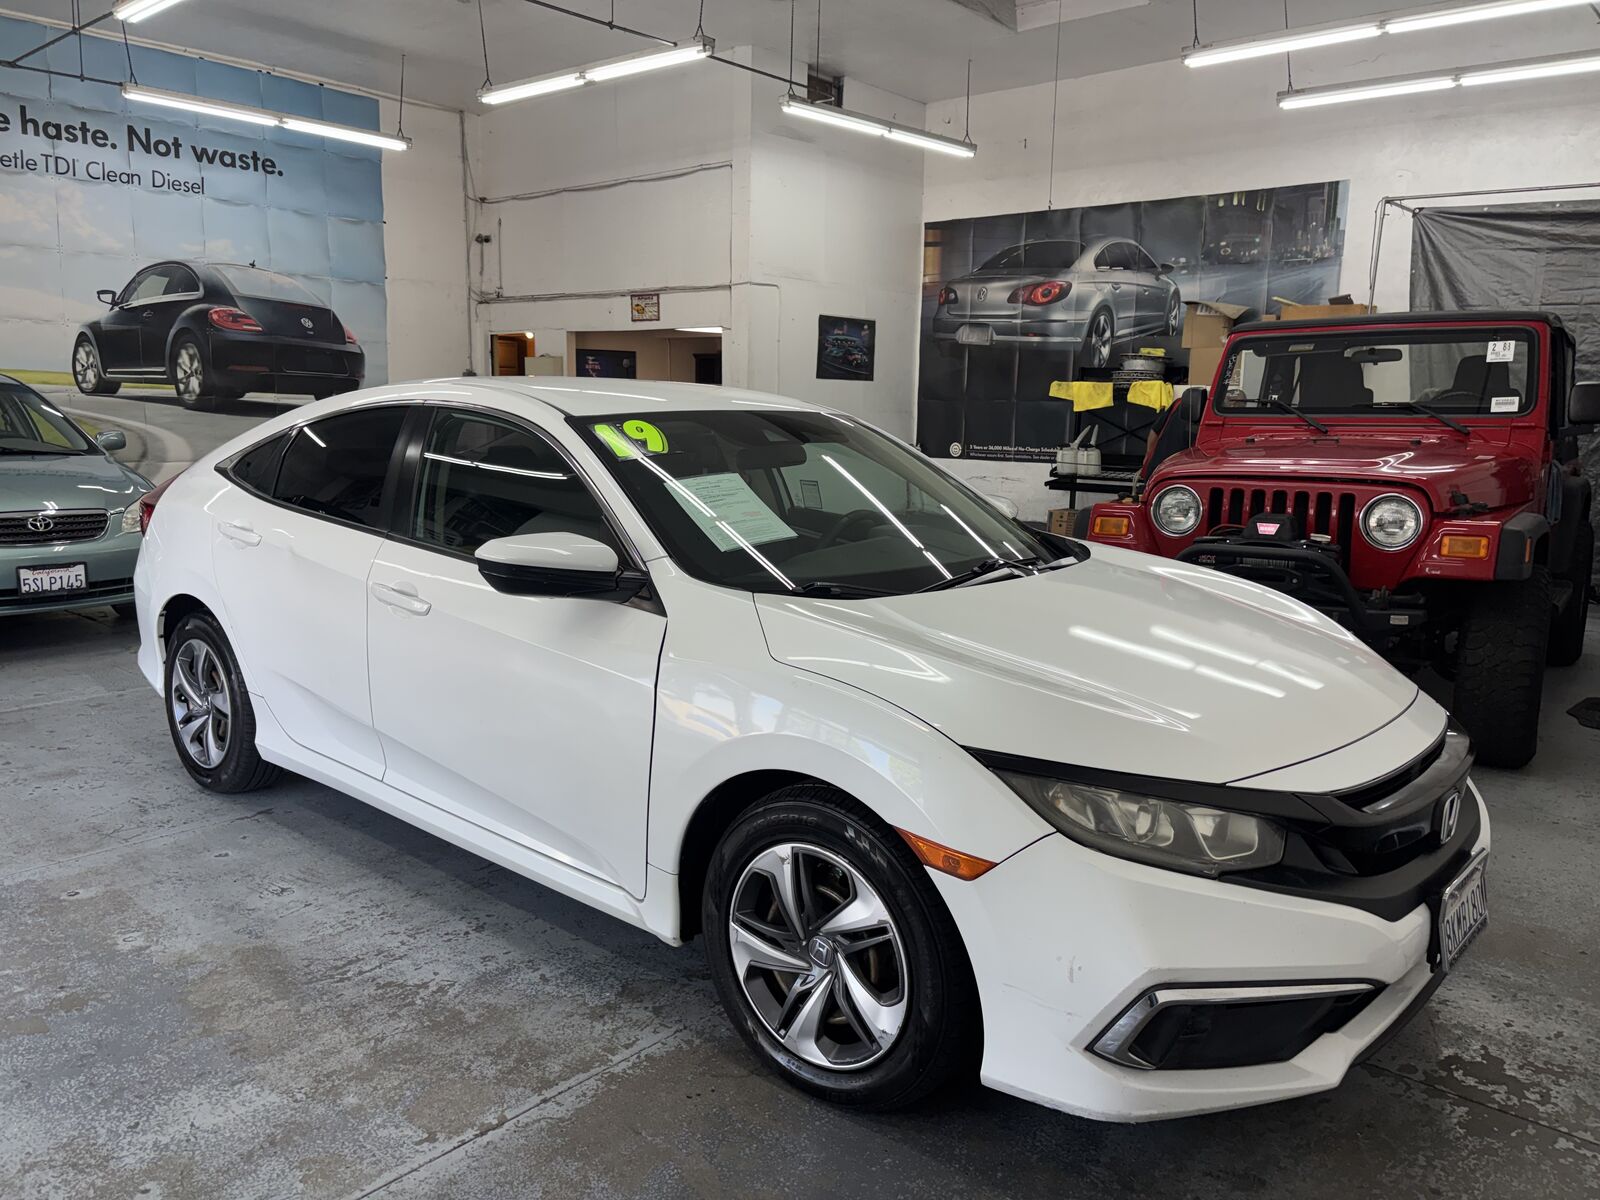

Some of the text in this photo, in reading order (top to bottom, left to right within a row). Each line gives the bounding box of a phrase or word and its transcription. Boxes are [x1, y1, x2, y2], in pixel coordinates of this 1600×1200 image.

[20, 105, 118, 149] haste.
[127, 124, 183, 159] Not
[190, 144, 284, 177] waste.
[0, 149, 205, 195] etle TDI Clean Diesel
[22, 573, 84, 592] 5SLP145
